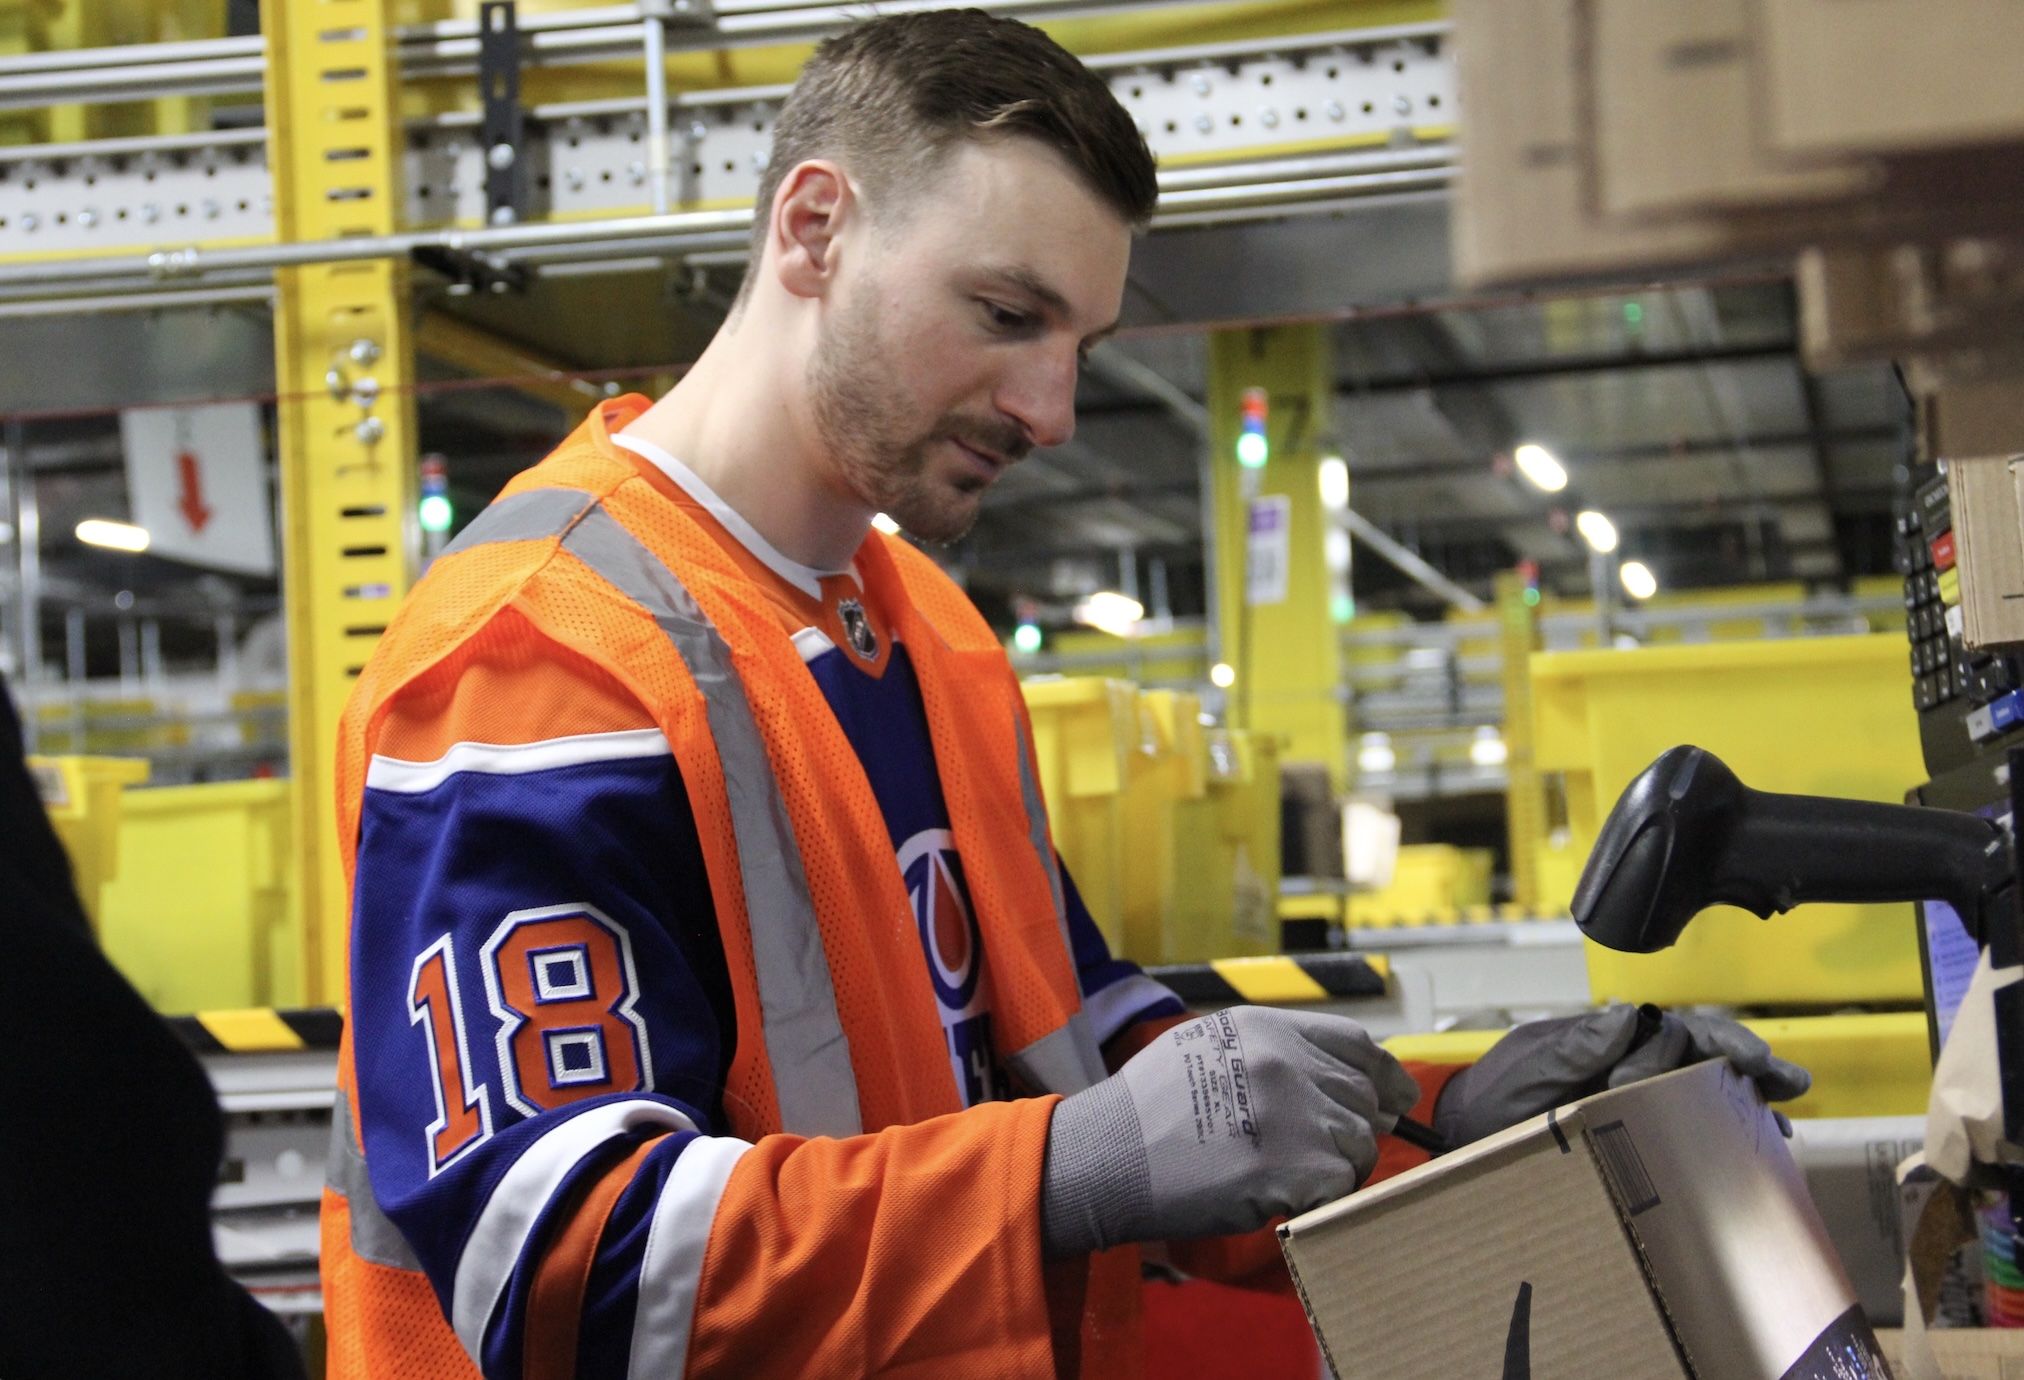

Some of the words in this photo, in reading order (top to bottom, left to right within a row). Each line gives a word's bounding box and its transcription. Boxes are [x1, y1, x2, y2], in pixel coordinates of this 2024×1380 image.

[407, 902, 655, 1180] 18
[1203, 1017, 1224, 1067] SAFETY
[1219, 1075, 1236, 1139] GEAR
[1209, 1069, 1219, 1092] SIZE
[1216, 1009, 1237, 1051] Body
[1231, 1058, 1258, 1137] Guard
